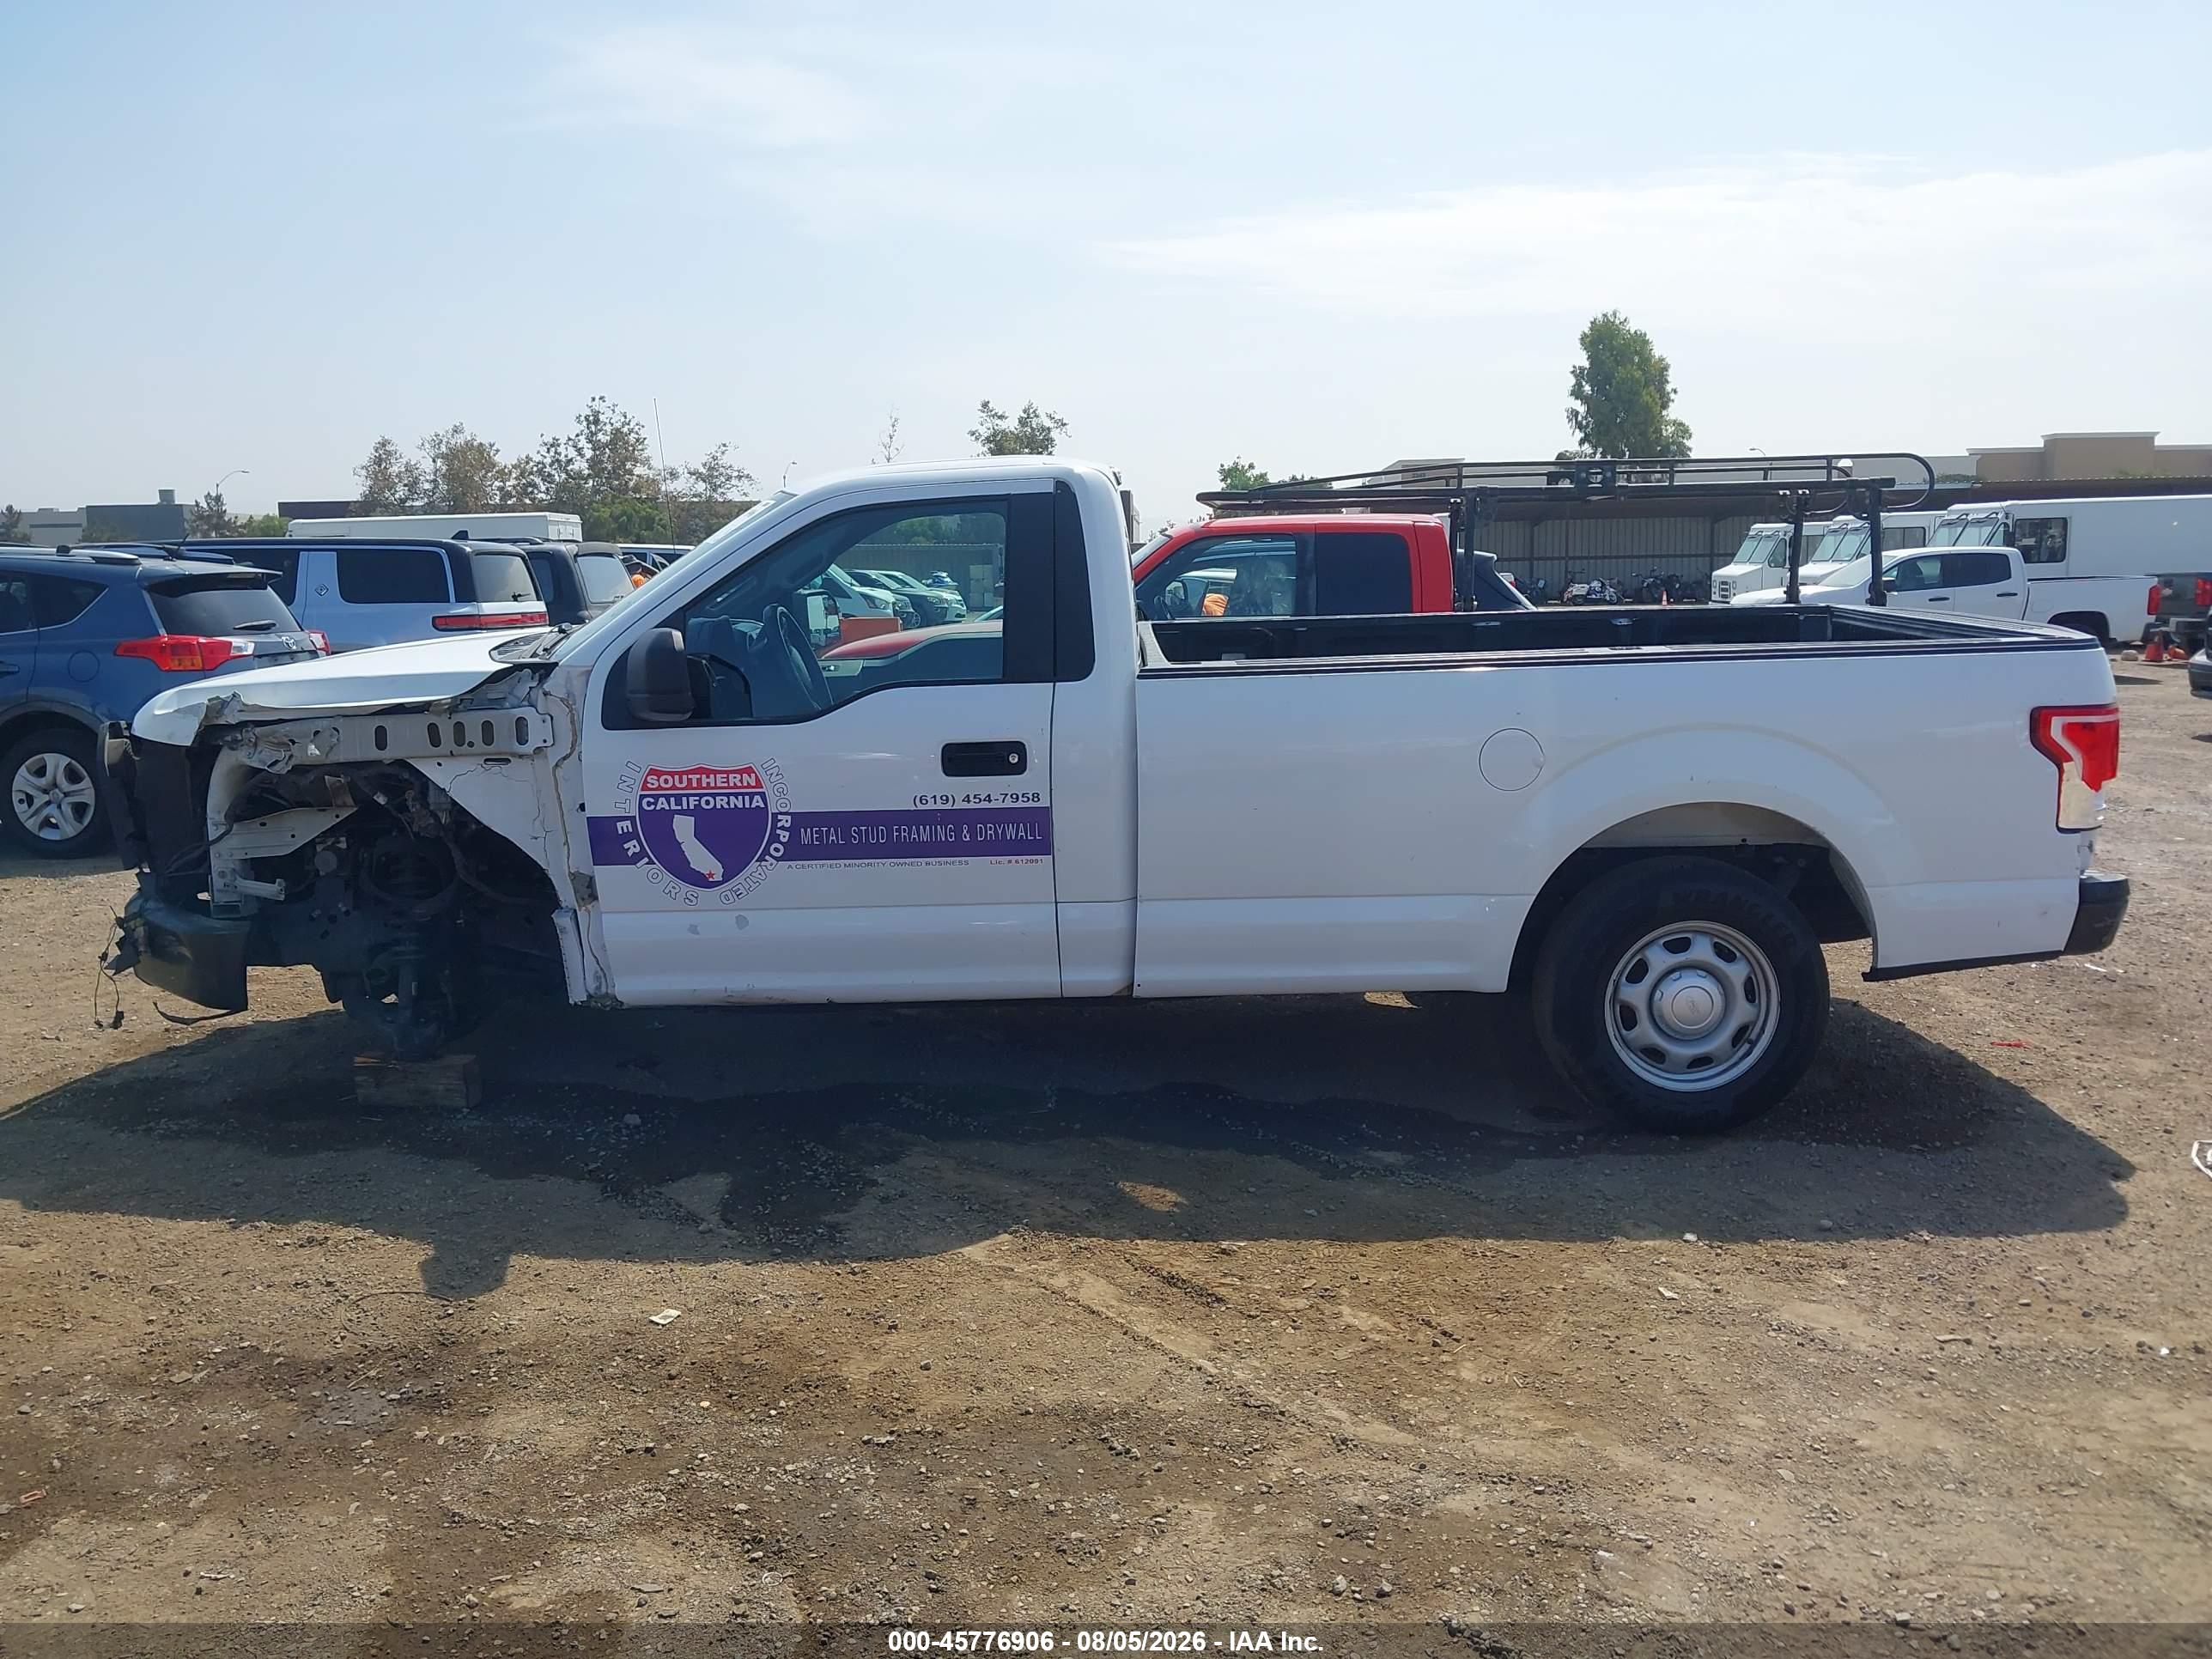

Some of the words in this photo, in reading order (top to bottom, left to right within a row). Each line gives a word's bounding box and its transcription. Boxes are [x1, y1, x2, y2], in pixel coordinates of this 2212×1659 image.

[646, 773, 757, 788] SOUTHERN
[641, 794, 765, 811] CALIFORNIA
[913, 793, 957, 808] (619)
[961, 792, 1041, 805] 454-7958
[614, 760, 699, 907] INTERIORS
[720, 757, 793, 906] INCORPORATED
[799, 826, 846, 846] METAL
[851, 825, 887, 845] STUD
[892, 823, 956, 843] FRAMING
[962, 823, 971, 842] &
[976, 822, 1043, 842] DRYWALL
